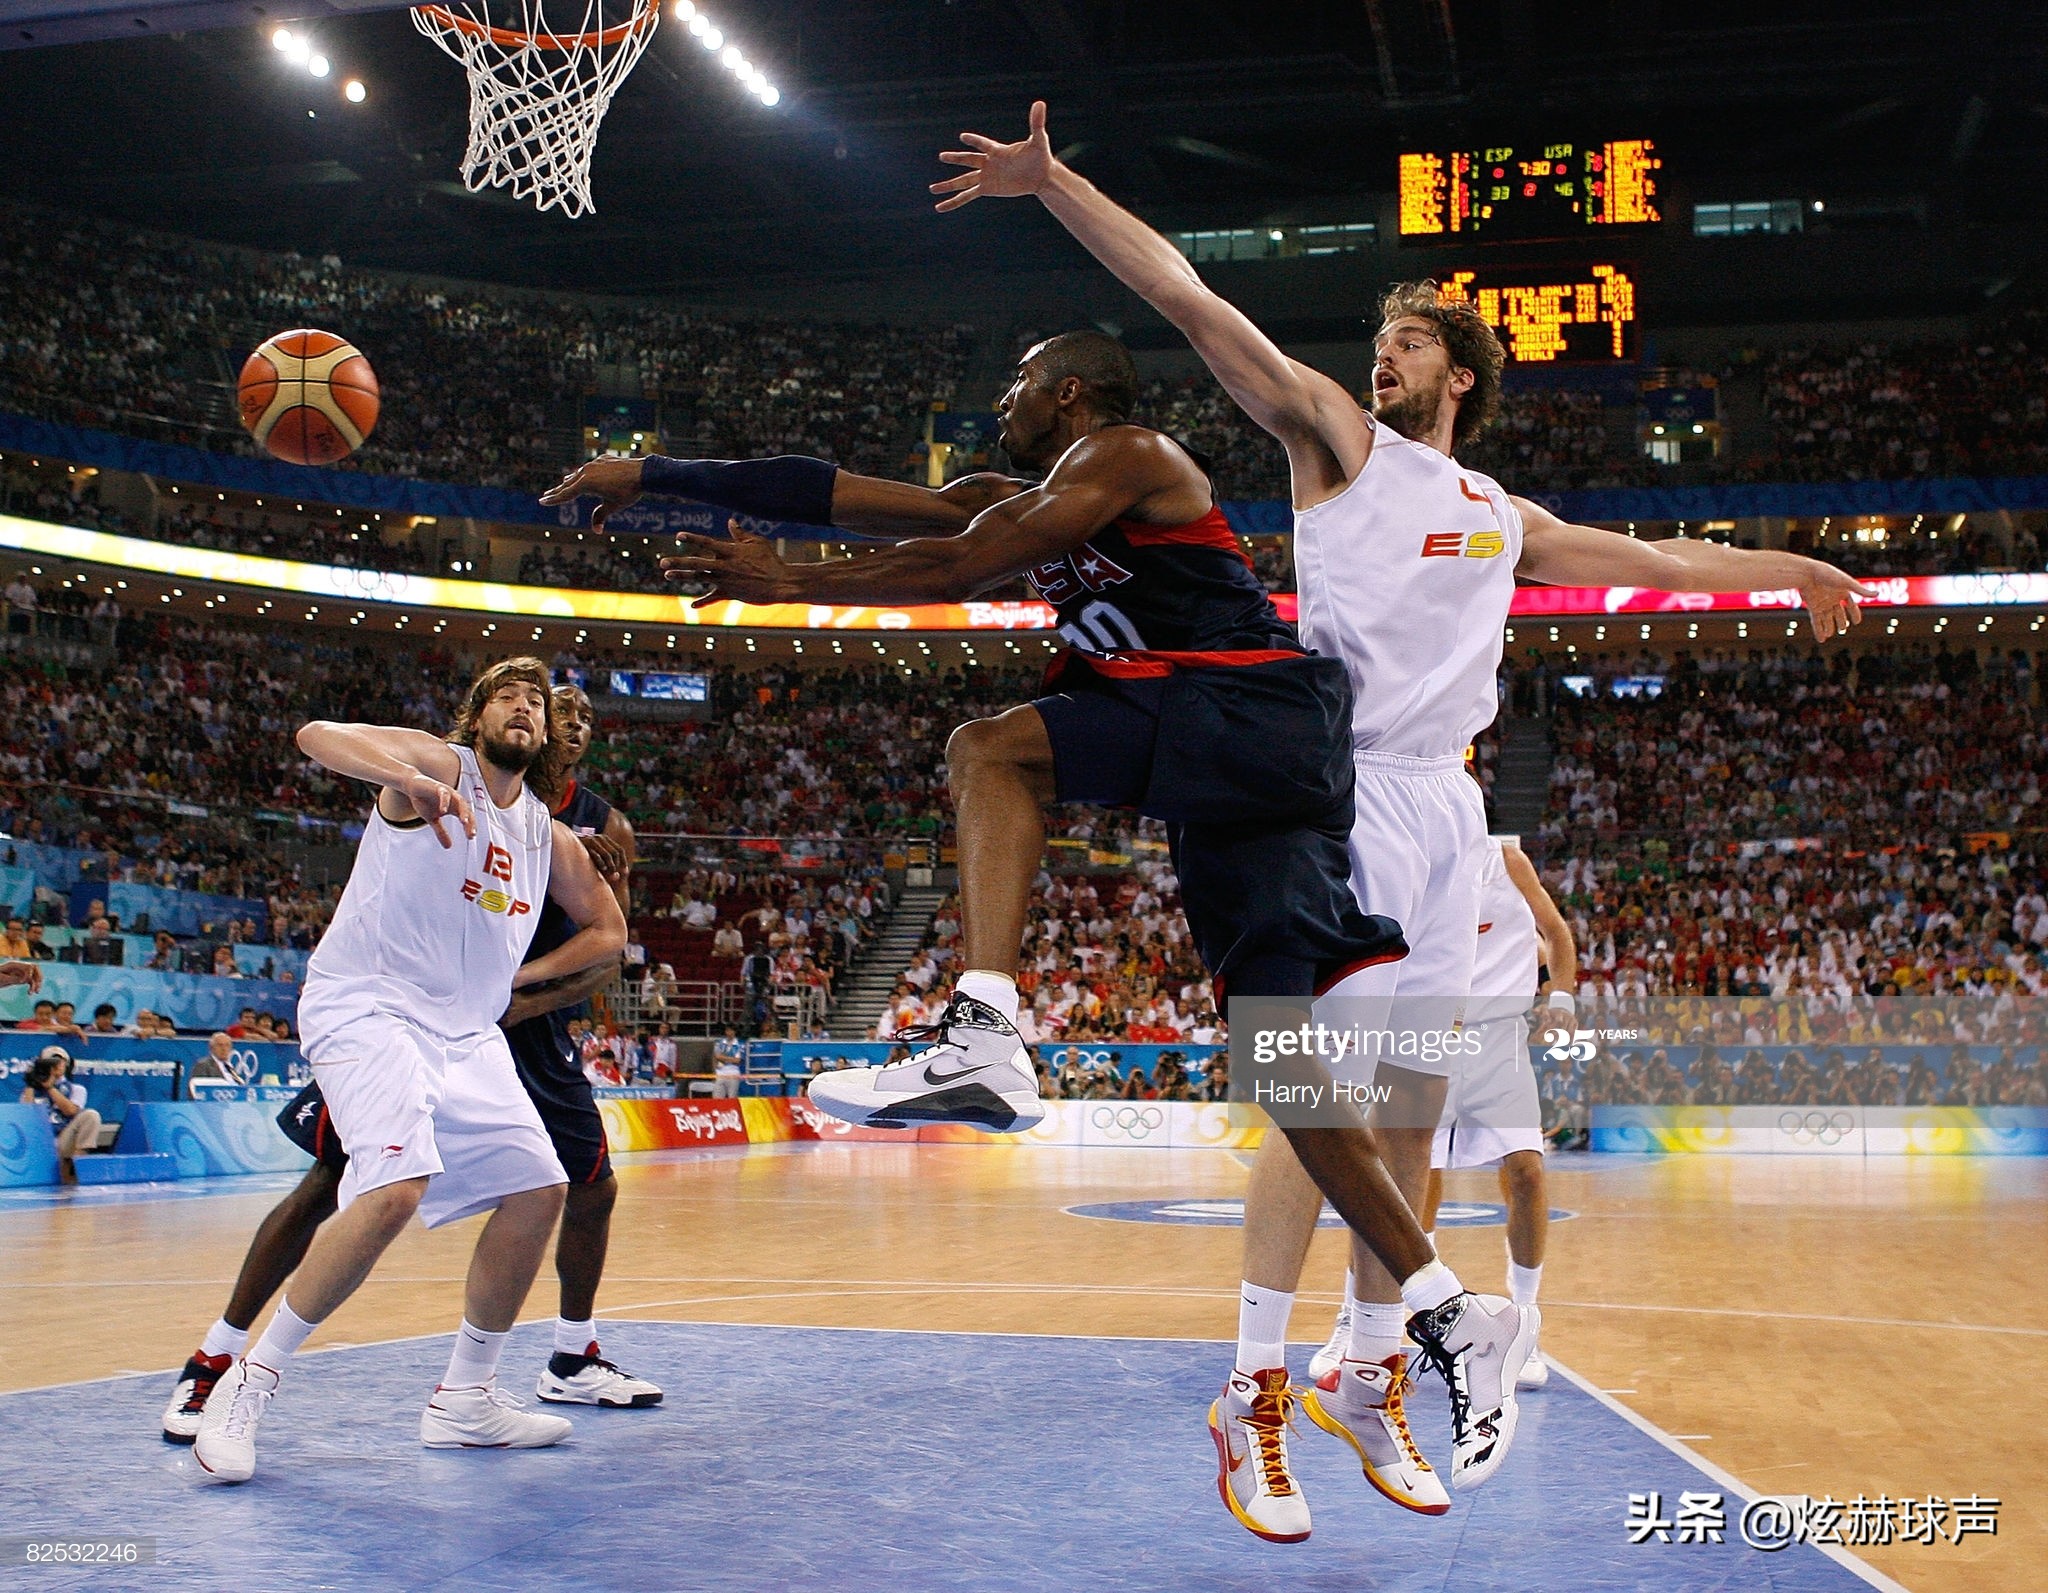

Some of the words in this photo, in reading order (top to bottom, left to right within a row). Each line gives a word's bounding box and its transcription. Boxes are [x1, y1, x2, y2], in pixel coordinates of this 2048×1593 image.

[1485, 147, 1513, 162] ESP
[1544, 143, 1573, 158] USA
[1518, 161, 1551, 176] 7:30
[1490, 186, 1511, 200] 33
[1523, 182, 1537, 197] 2
[1554, 182, 1574, 196] 46
[1502, 287, 1535, 298] FIELD
[1539, 285, 1571, 296] GOALS
[1503, 315, 1529, 325] FREE
[669, 511, 713, 529] 2008
[1023, 542, 1134, 605] SA
[961, 601, 1047, 631] Beijing
[483, 842, 514, 882] 13
[460, 878, 531, 917] ESP
[669, 1106, 716, 1140] Beijing
